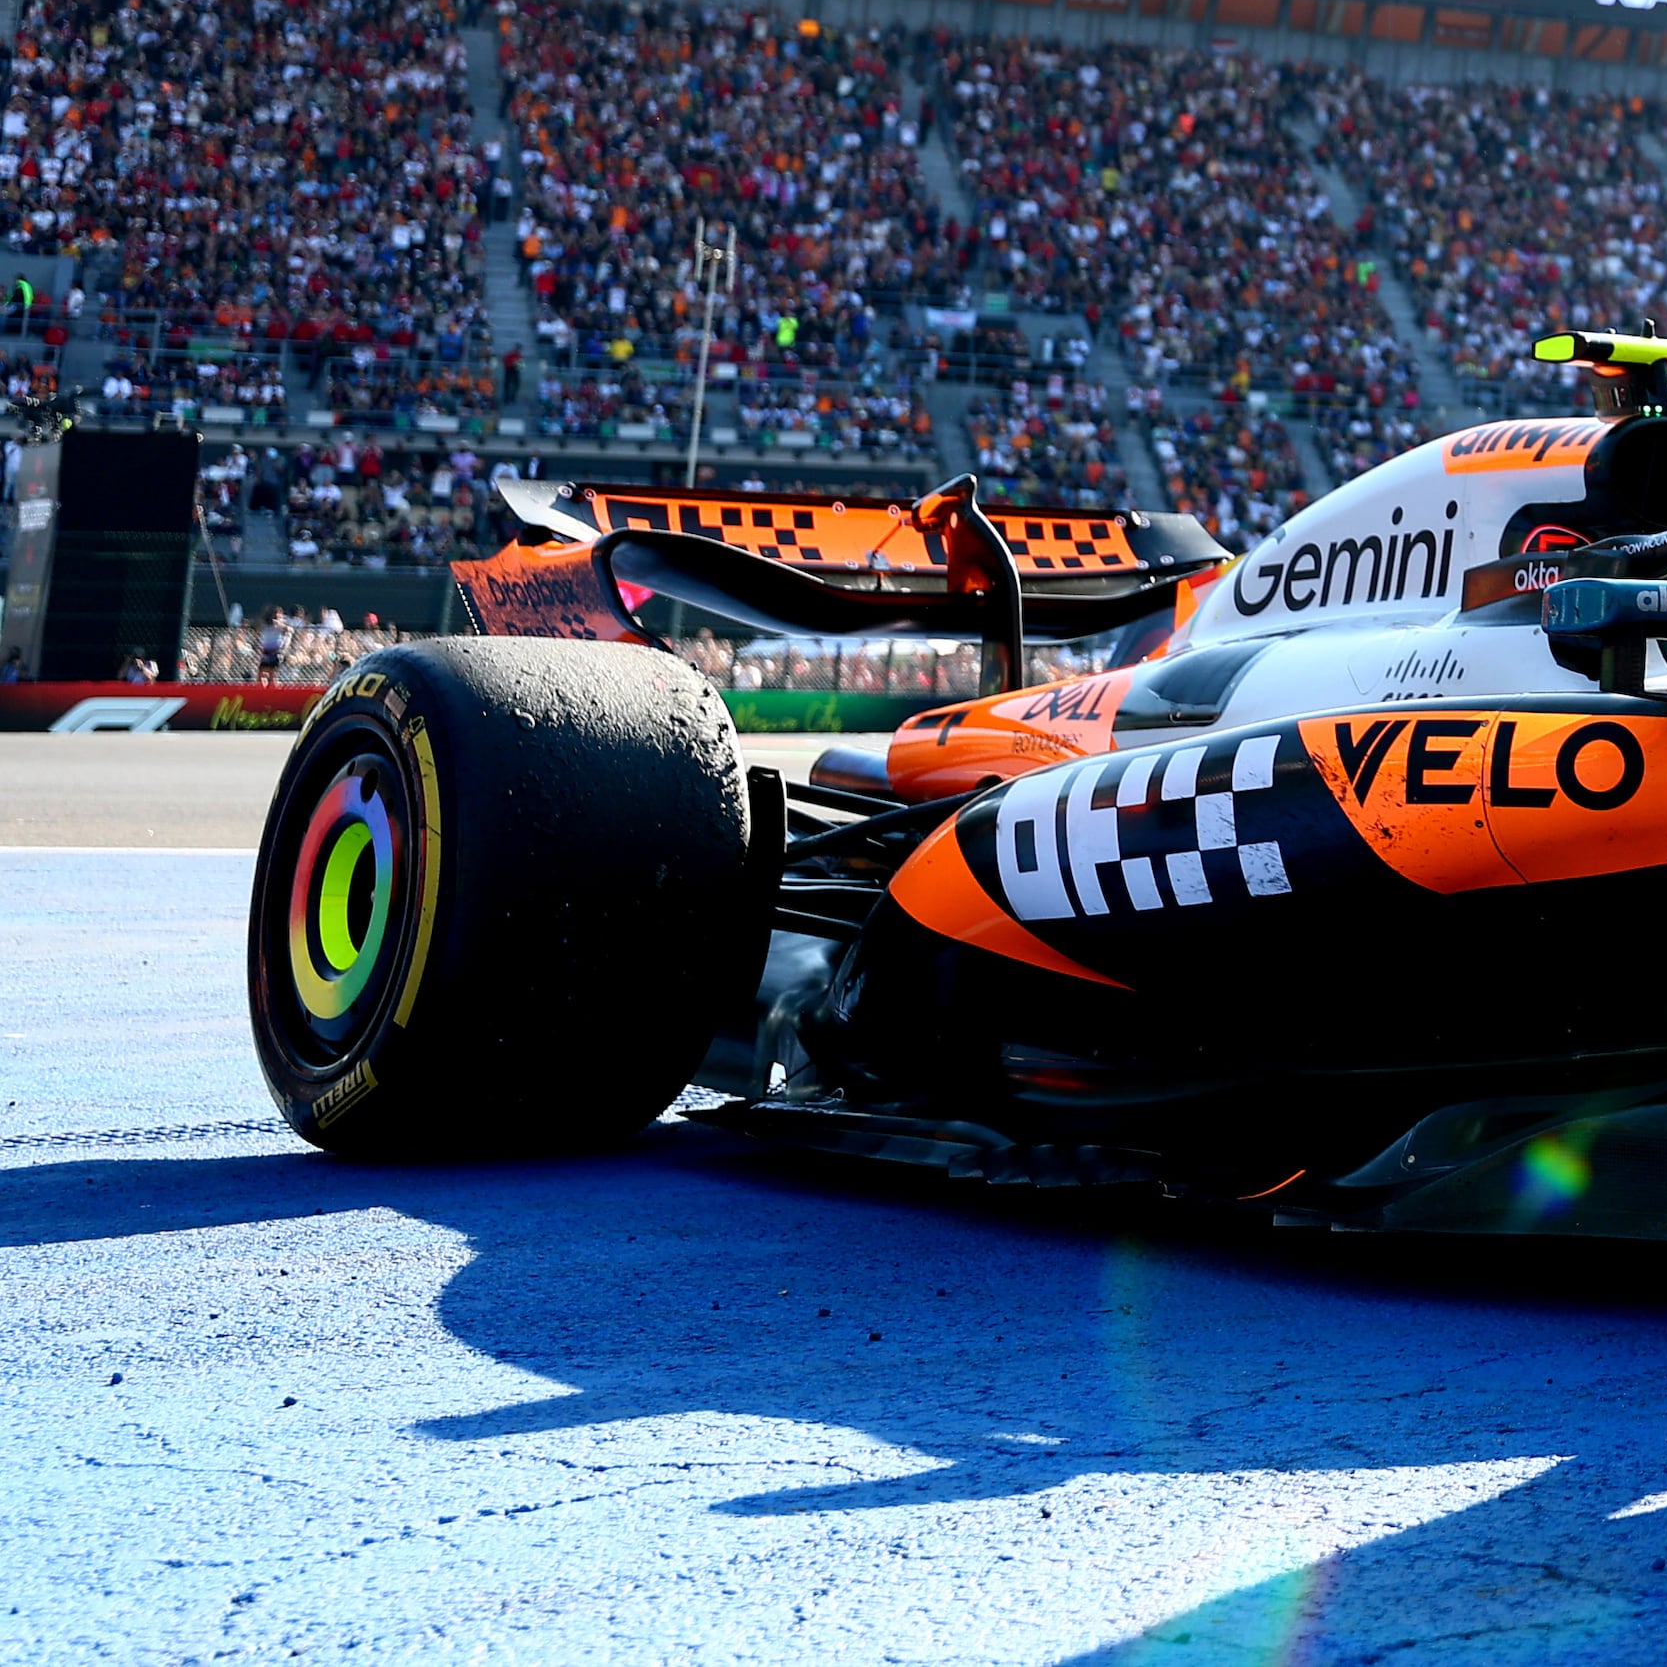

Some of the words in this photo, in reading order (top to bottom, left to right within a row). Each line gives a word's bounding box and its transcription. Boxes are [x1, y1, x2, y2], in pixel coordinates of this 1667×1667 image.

[1451, 424, 1603, 462] allwyn
[1233, 500, 1461, 617] Gemini
[1514, 561, 1561, 592] okta
[1020, 681, 1111, 722] DELL
[1335, 719, 1645, 811] VELO
[312, 1057, 379, 1130] PIRELLI
